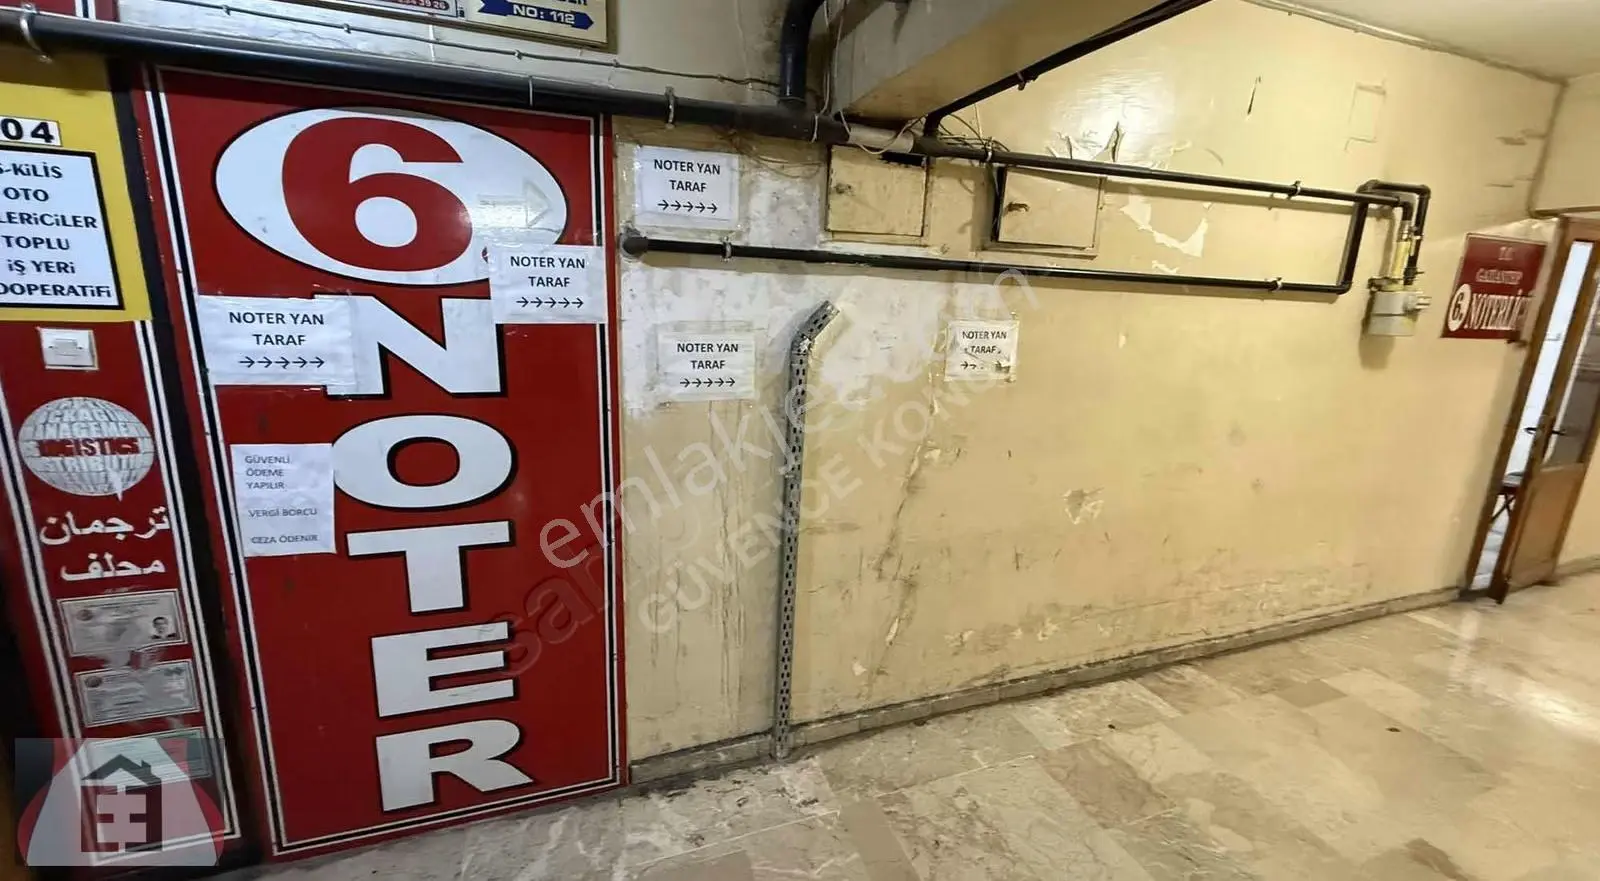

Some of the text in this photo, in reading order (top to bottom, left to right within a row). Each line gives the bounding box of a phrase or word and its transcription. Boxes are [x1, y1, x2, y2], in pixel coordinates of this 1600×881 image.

[512, 4, 576, 24] NO: 112
[653, 159, 721, 175] NOTER YAN
[669, 179, 707, 193] TARAF
[3, 187, 49, 202] OTO
[2, 235, 70, 250] TOPLU
[510, 256, 585, 269] NOTER YAN
[528, 276, 571, 288] TARAF
[229, 311, 324, 325] NOTER YAN
[252, 333, 306, 346] TARAF
[962, 331, 1007, 340] NOTER YAN
[677, 342, 739, 353] NOTER YAN
[970, 345, 997, 354] TARAF
[690, 359, 726, 370] TARAF
[246, 467, 284, 477] ÖDEME
[39, 505, 171, 546] ترجمان
[251, 536, 277, 544] CEZA
[326, 293, 533, 813] NOTER
[60, 551, 166, 581] محلف
